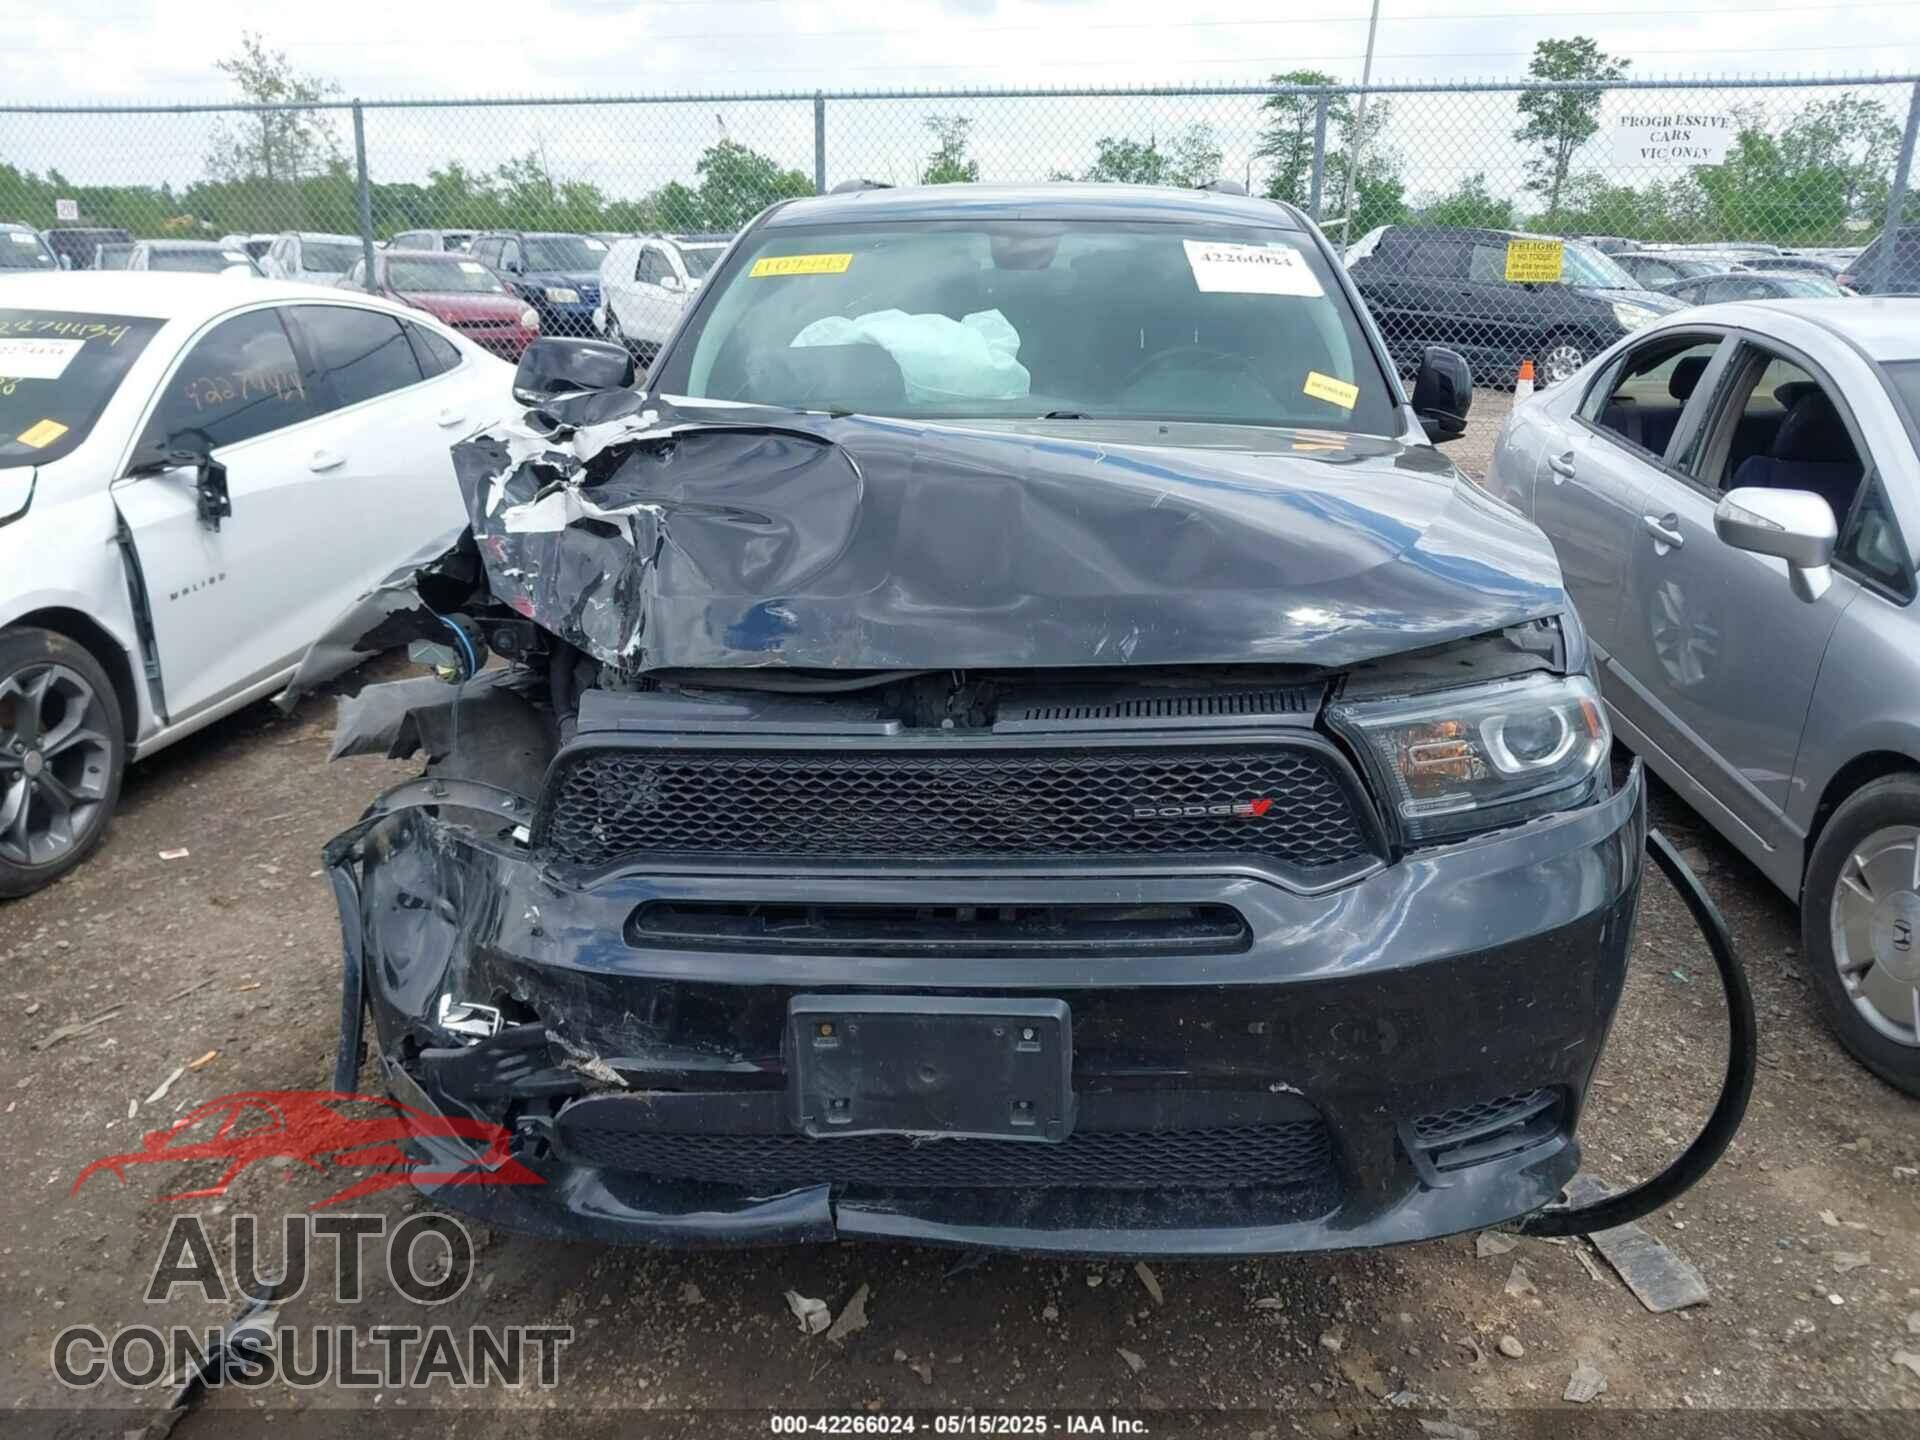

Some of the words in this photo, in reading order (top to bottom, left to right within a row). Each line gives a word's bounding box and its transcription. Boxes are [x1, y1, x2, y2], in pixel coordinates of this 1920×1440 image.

[1621, 114, 1729, 128] PROGRESSIVE
[1650, 129, 1691, 142] CARS
[1671, 146, 1711, 158] ONLY
[1134, 804, 1255, 817] DODGE
